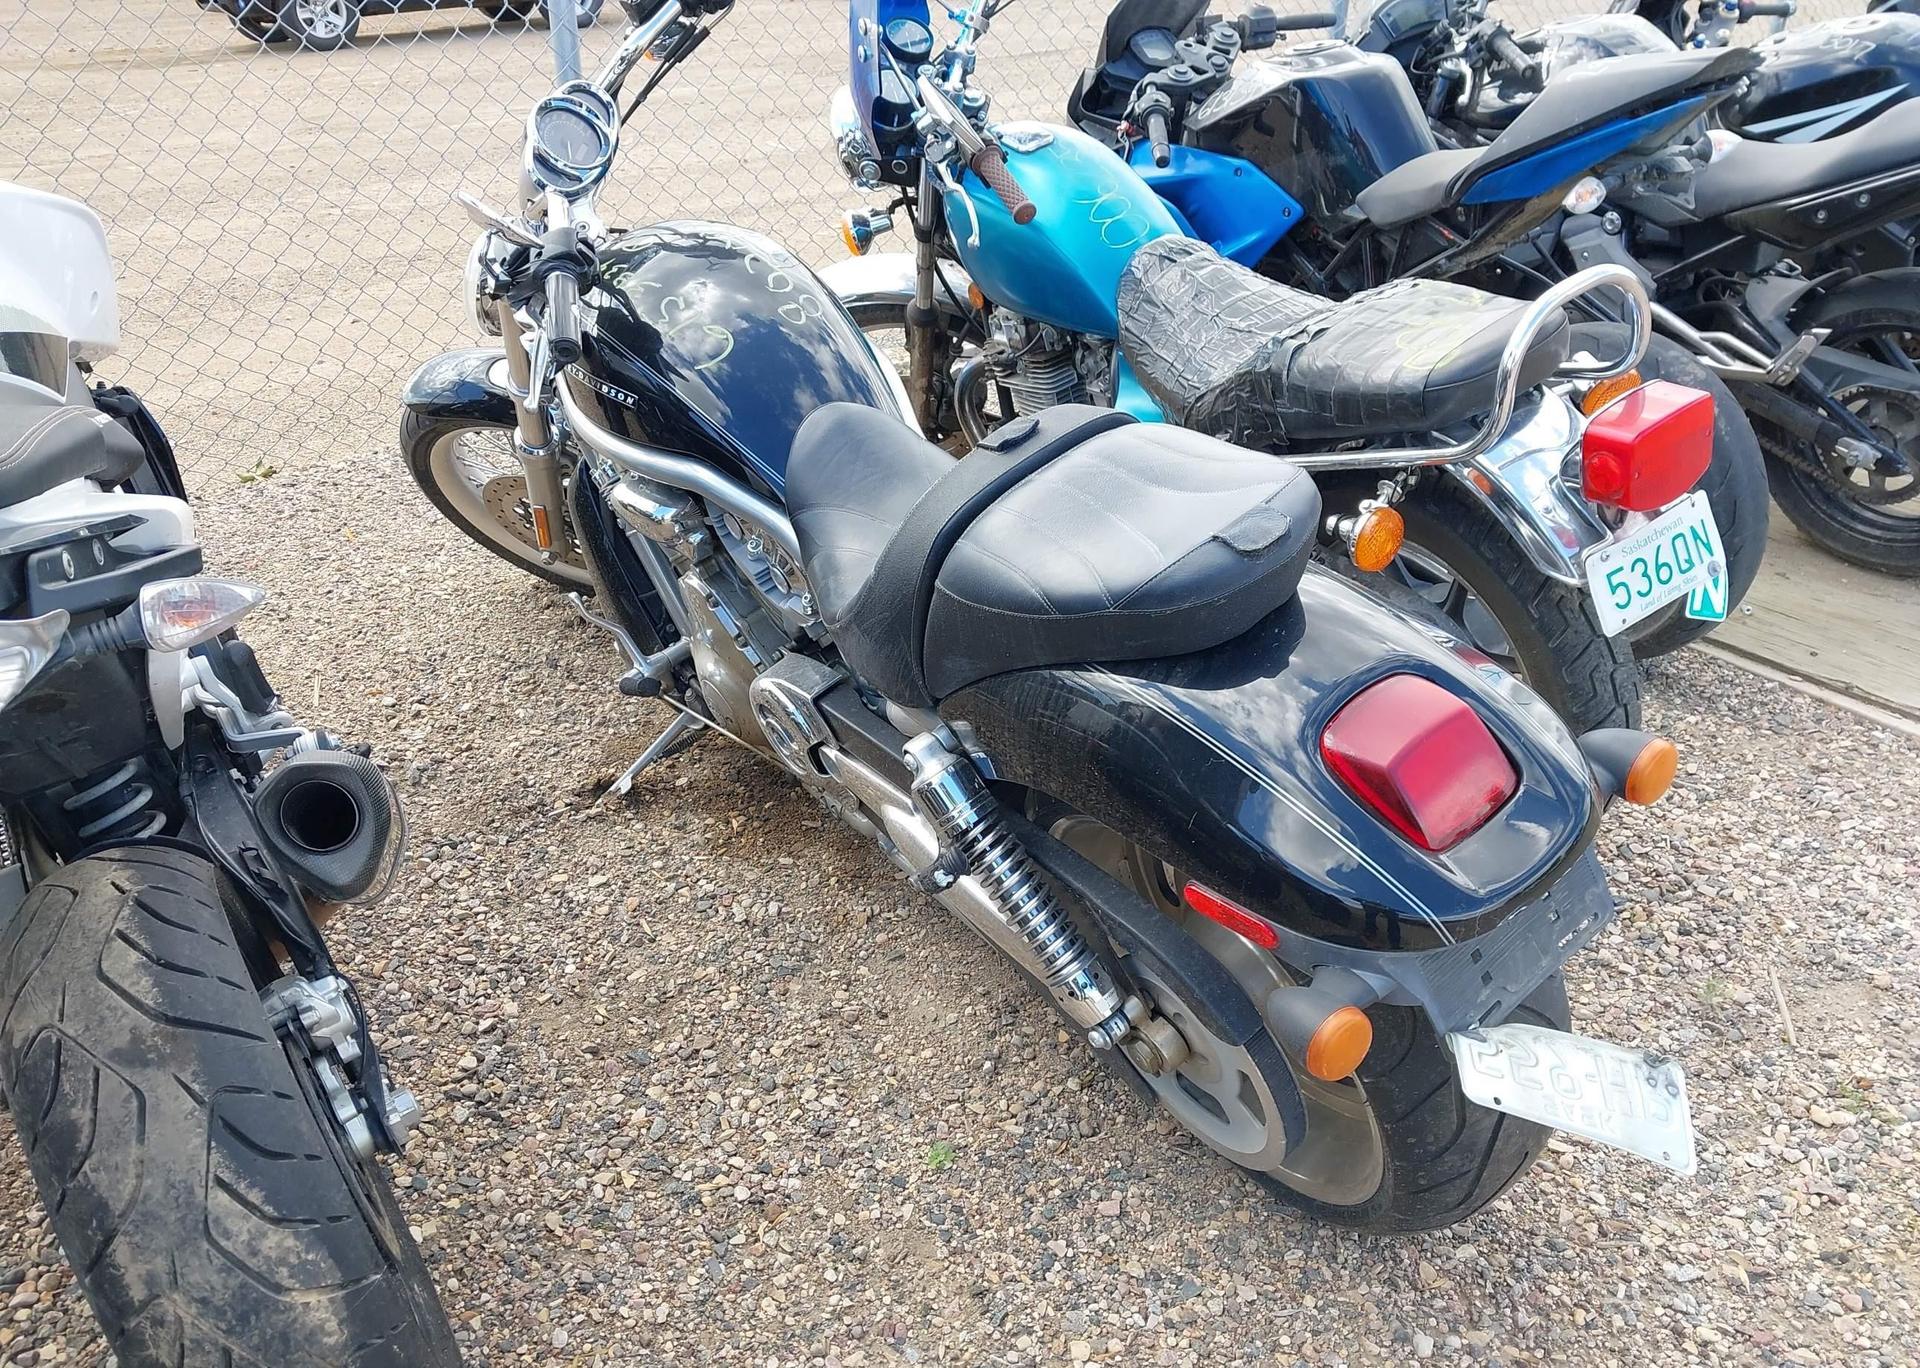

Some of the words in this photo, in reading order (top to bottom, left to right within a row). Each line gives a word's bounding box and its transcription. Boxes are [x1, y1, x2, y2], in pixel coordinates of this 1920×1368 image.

[565, 362, 635, 405] EY-DAVIDSON
[1621, 516, 1684, 558] Saskatchewan
[1606, 519, 1714, 610] 536QN
